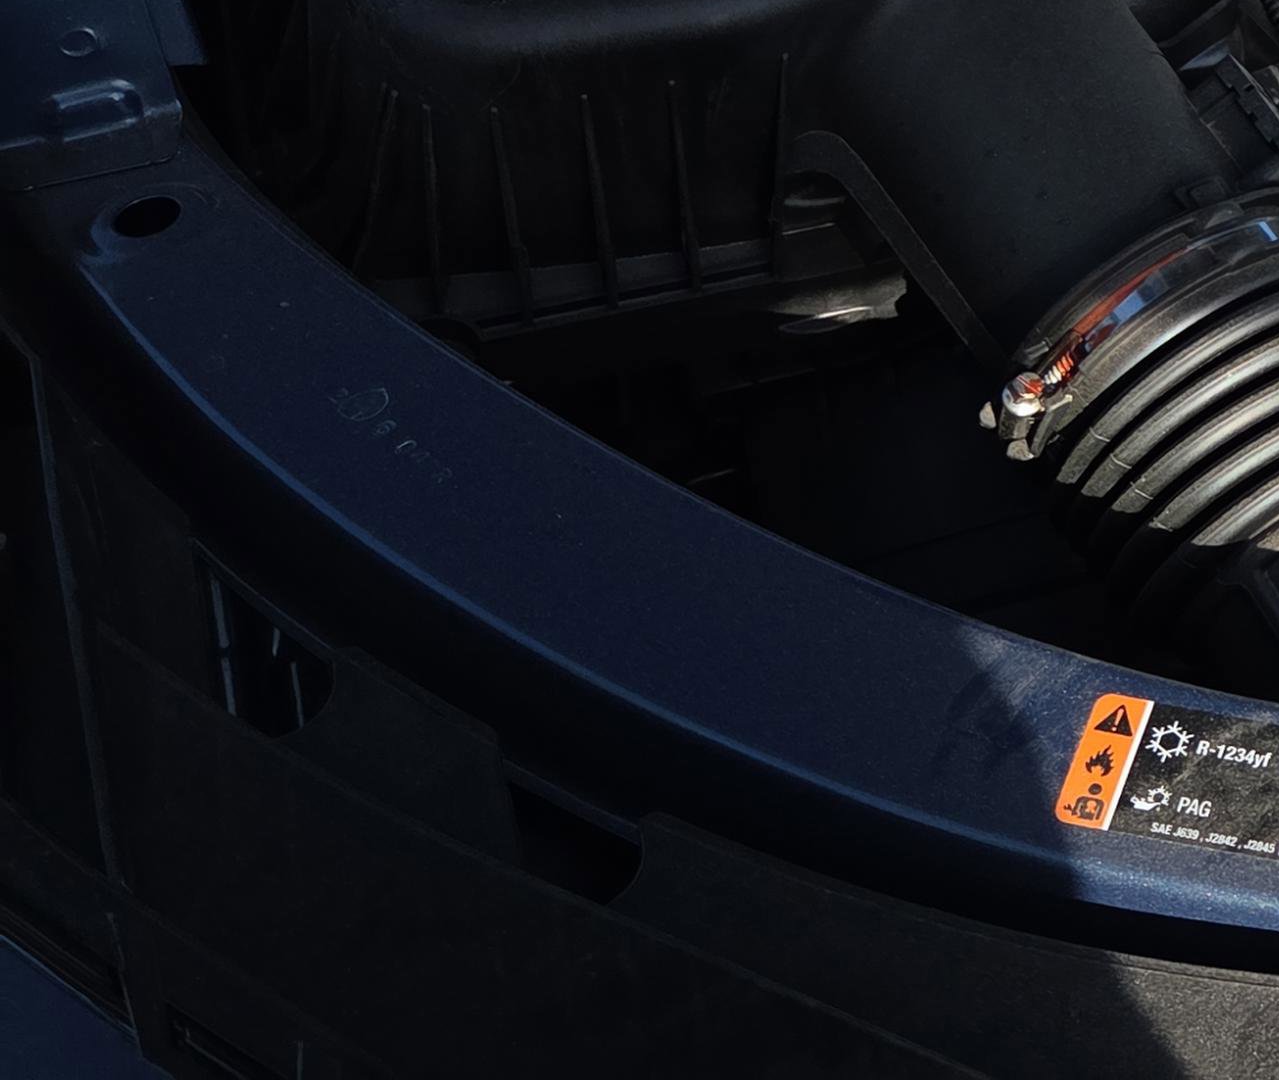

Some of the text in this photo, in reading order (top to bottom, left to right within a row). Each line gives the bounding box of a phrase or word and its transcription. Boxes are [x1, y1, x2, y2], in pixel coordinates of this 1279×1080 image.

[1195, 741, 1272, 769] R-1234yf
[1177, 796, 1211, 818] PAG
[1150, 822, 1173, 836] SAE
